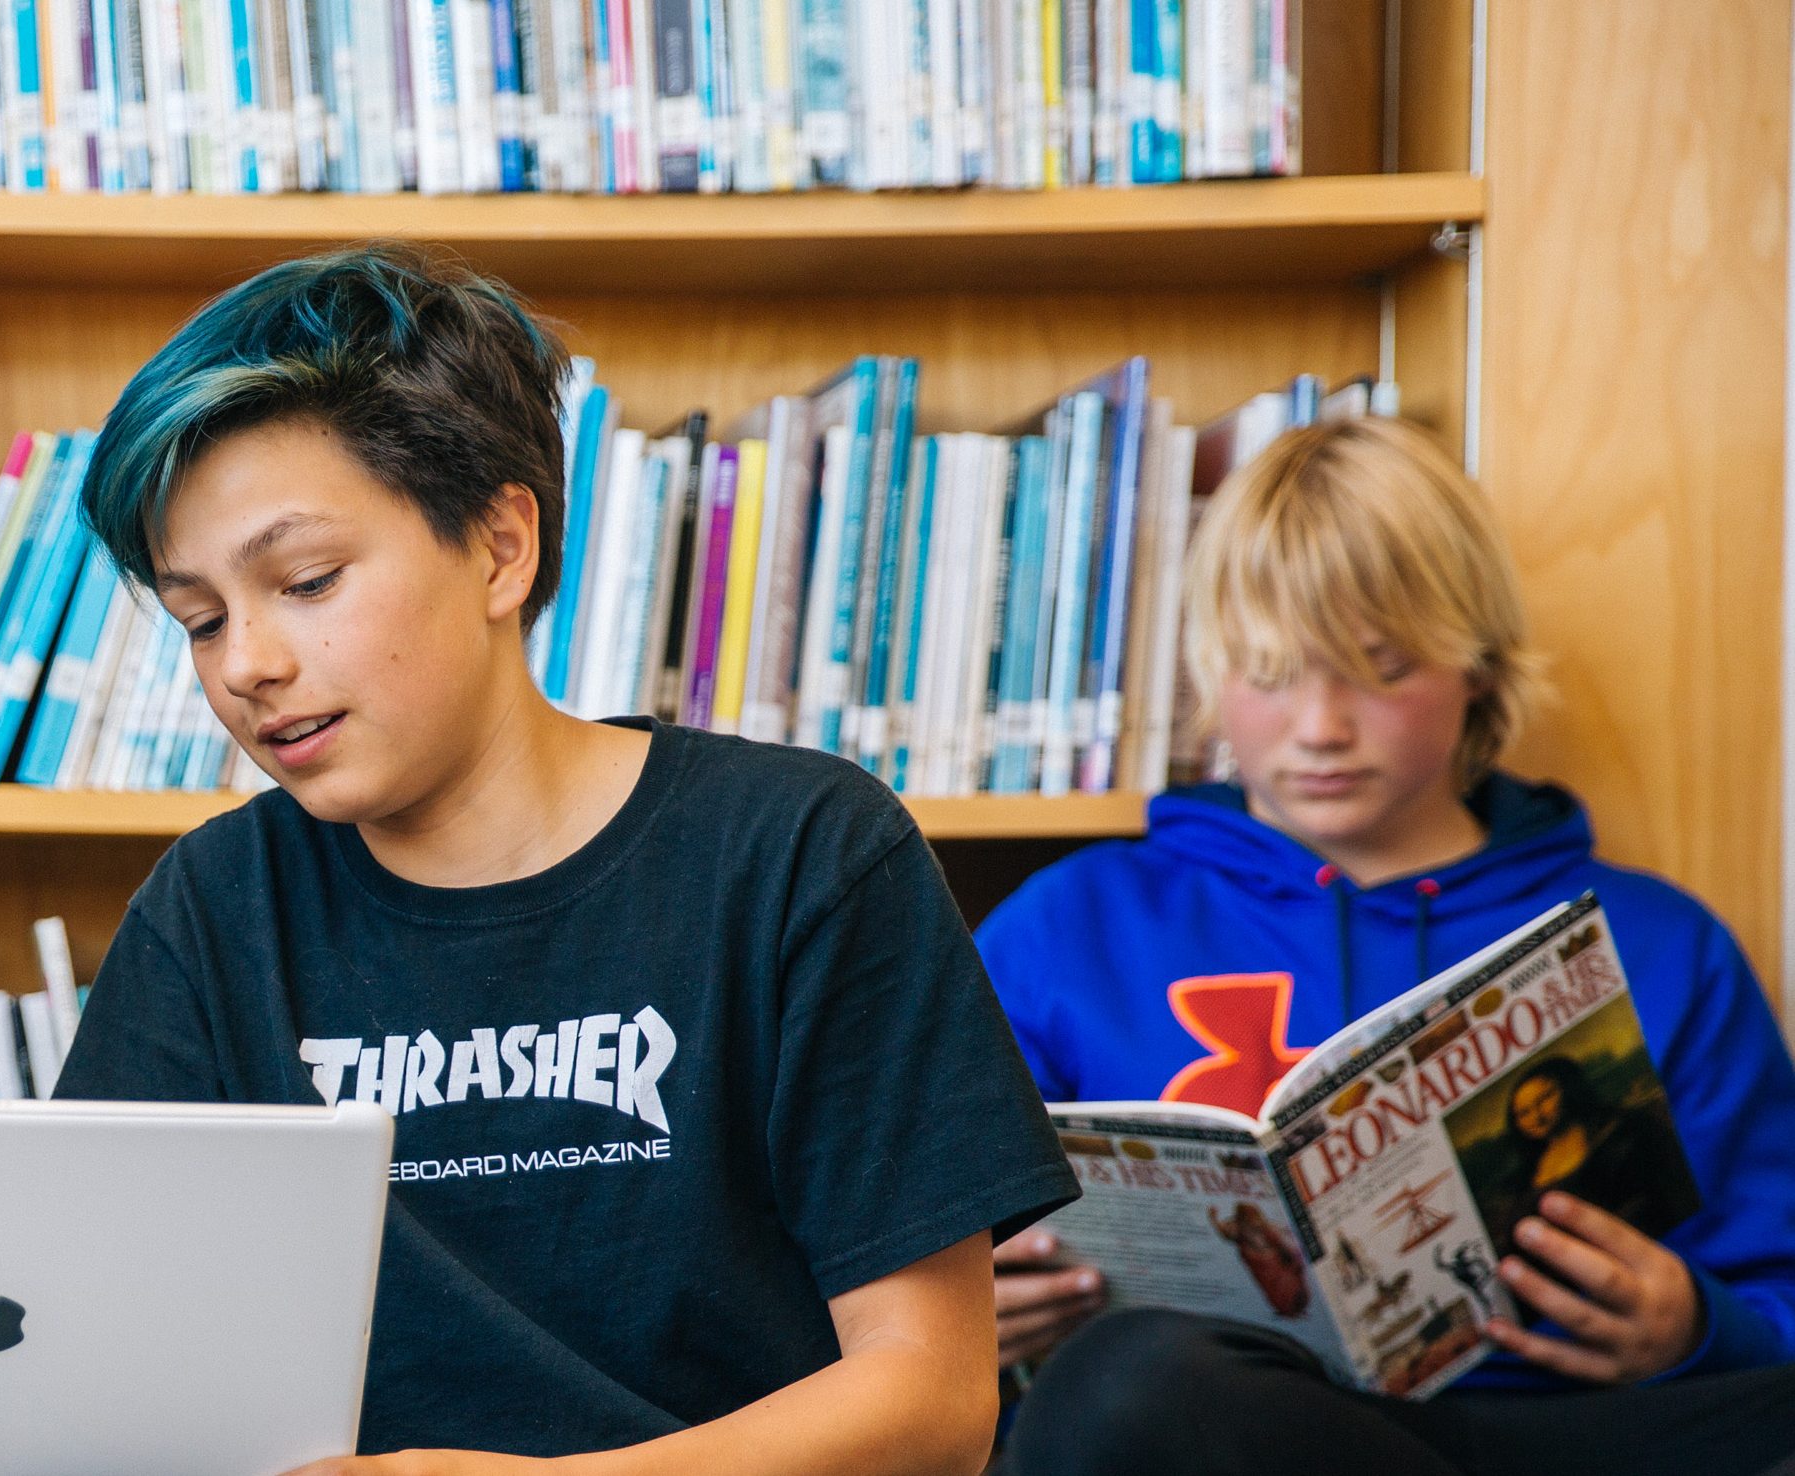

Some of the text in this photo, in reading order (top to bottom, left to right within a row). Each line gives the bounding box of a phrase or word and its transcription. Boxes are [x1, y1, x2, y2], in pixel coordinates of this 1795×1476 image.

[299, 1004, 677, 1135] THRASHER
[1287, 996, 1544, 1206] LEONARDO
[387, 1138, 671, 1182] EBOARD MAGAZINE
